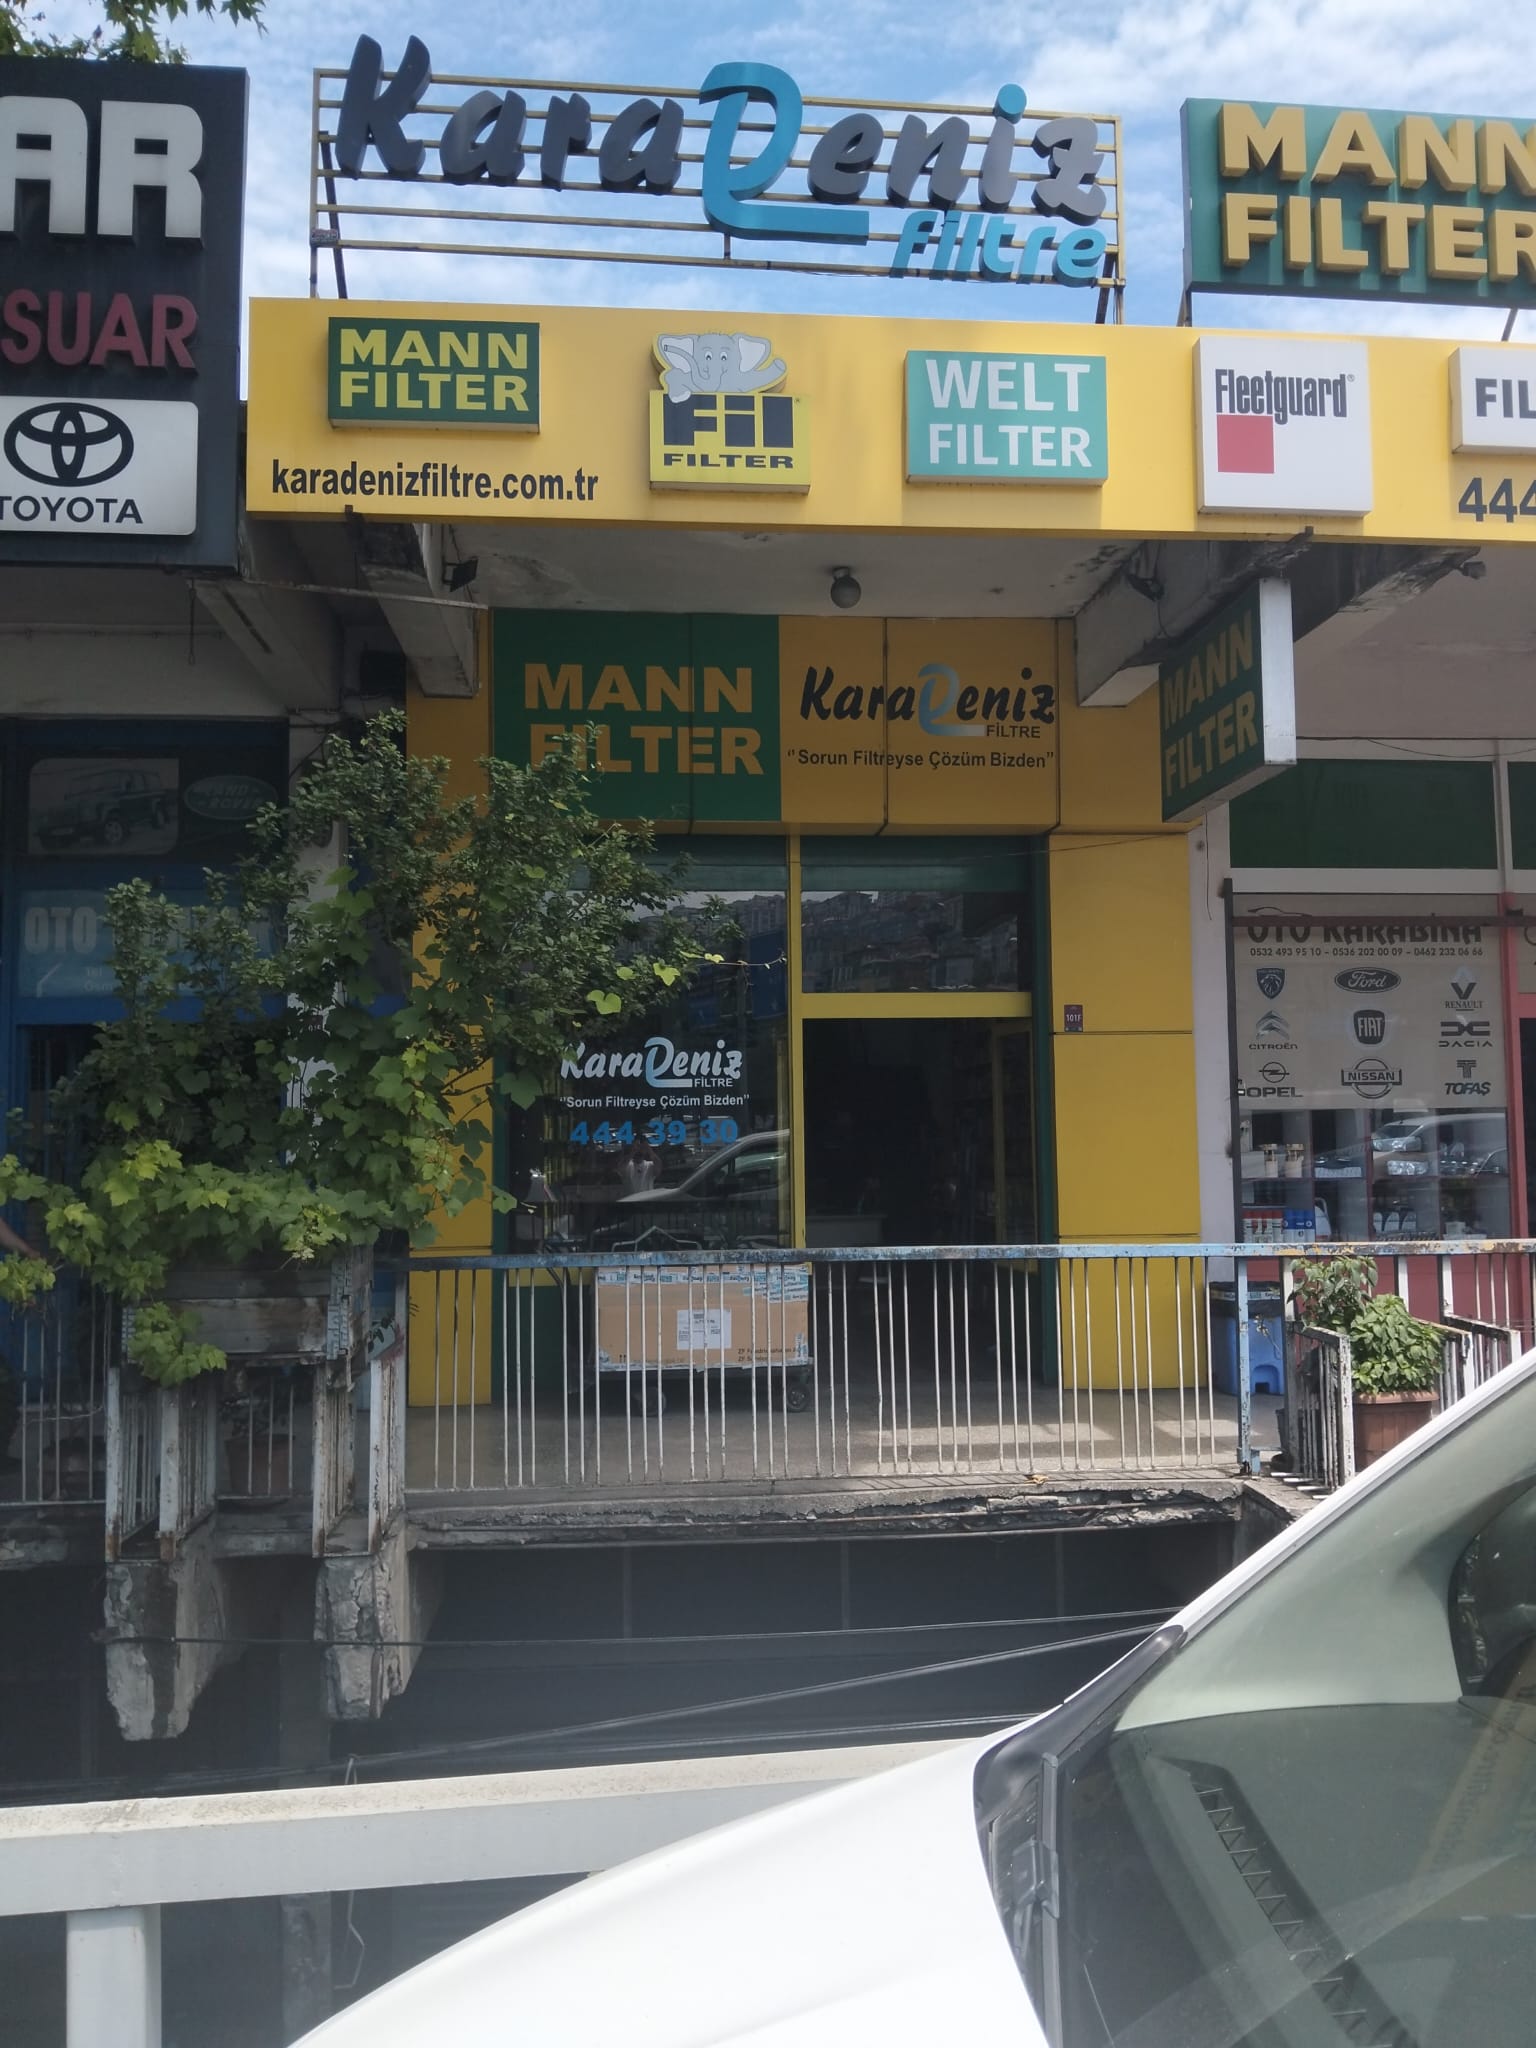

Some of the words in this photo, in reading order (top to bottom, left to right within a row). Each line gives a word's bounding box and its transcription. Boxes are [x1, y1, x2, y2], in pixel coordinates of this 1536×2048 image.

[335, 33, 1106, 241] KaraDeniz
[1219, 102, 1536, 197] MANN
[0, 96, 204, 240] AR
[890, 209, 1108, 287] filtre
[1223, 192, 1536, 283] FILTER
[0, 289, 199, 370] SUAR
[339, 328, 529, 370] MANN
[339, 371, 530, 413] FILTER
[924, 358, 1092, 413] WELT
[1475, 377, 1536, 419] FIL
[663, 452, 794, 469] FILTER
[928, 422, 1093, 468] FILTER
[271, 458, 599, 501] karadenizfiltre.com.tr
[523, 662, 753, 714] MANN
[1163, 607, 1254, 731] MANN
[799, 662, 1056, 737] KaraDeniz
[986, 721, 1042, 739] FİLTRE
[1164, 690, 1259, 798] FILTER
[853, 750, 925, 770] Filtreyse
[929, 750, 987, 771] Çözüm
[24, 906, 98, 954] OTO
[1250, 947, 1273, 956] 0532
[1347, 970, 1387, 989] Ford
[1444, 1000, 1484, 1009] RENAULT
[1357, 1016, 1383, 1038] FIAT
[1438, 1040, 1494, 1048] DACIA
[560, 1036, 743, 1088] KaraDeniz
[694, 1077, 734, 1088] FİLTRE
[1347, 1071, 1396, 1082] NISSAN
[605, 1095, 656, 1110] Filtreyse
[660, 1094, 701, 1110] Çözüm
[1246, 1086, 1304, 1098] OPEL
[1444, 1081, 1492, 1096] TOFAŞ
[569, 1120, 635, 1146] 444
[647, 1119, 687, 1146] 39
[700, 1119, 738, 1145] 30
